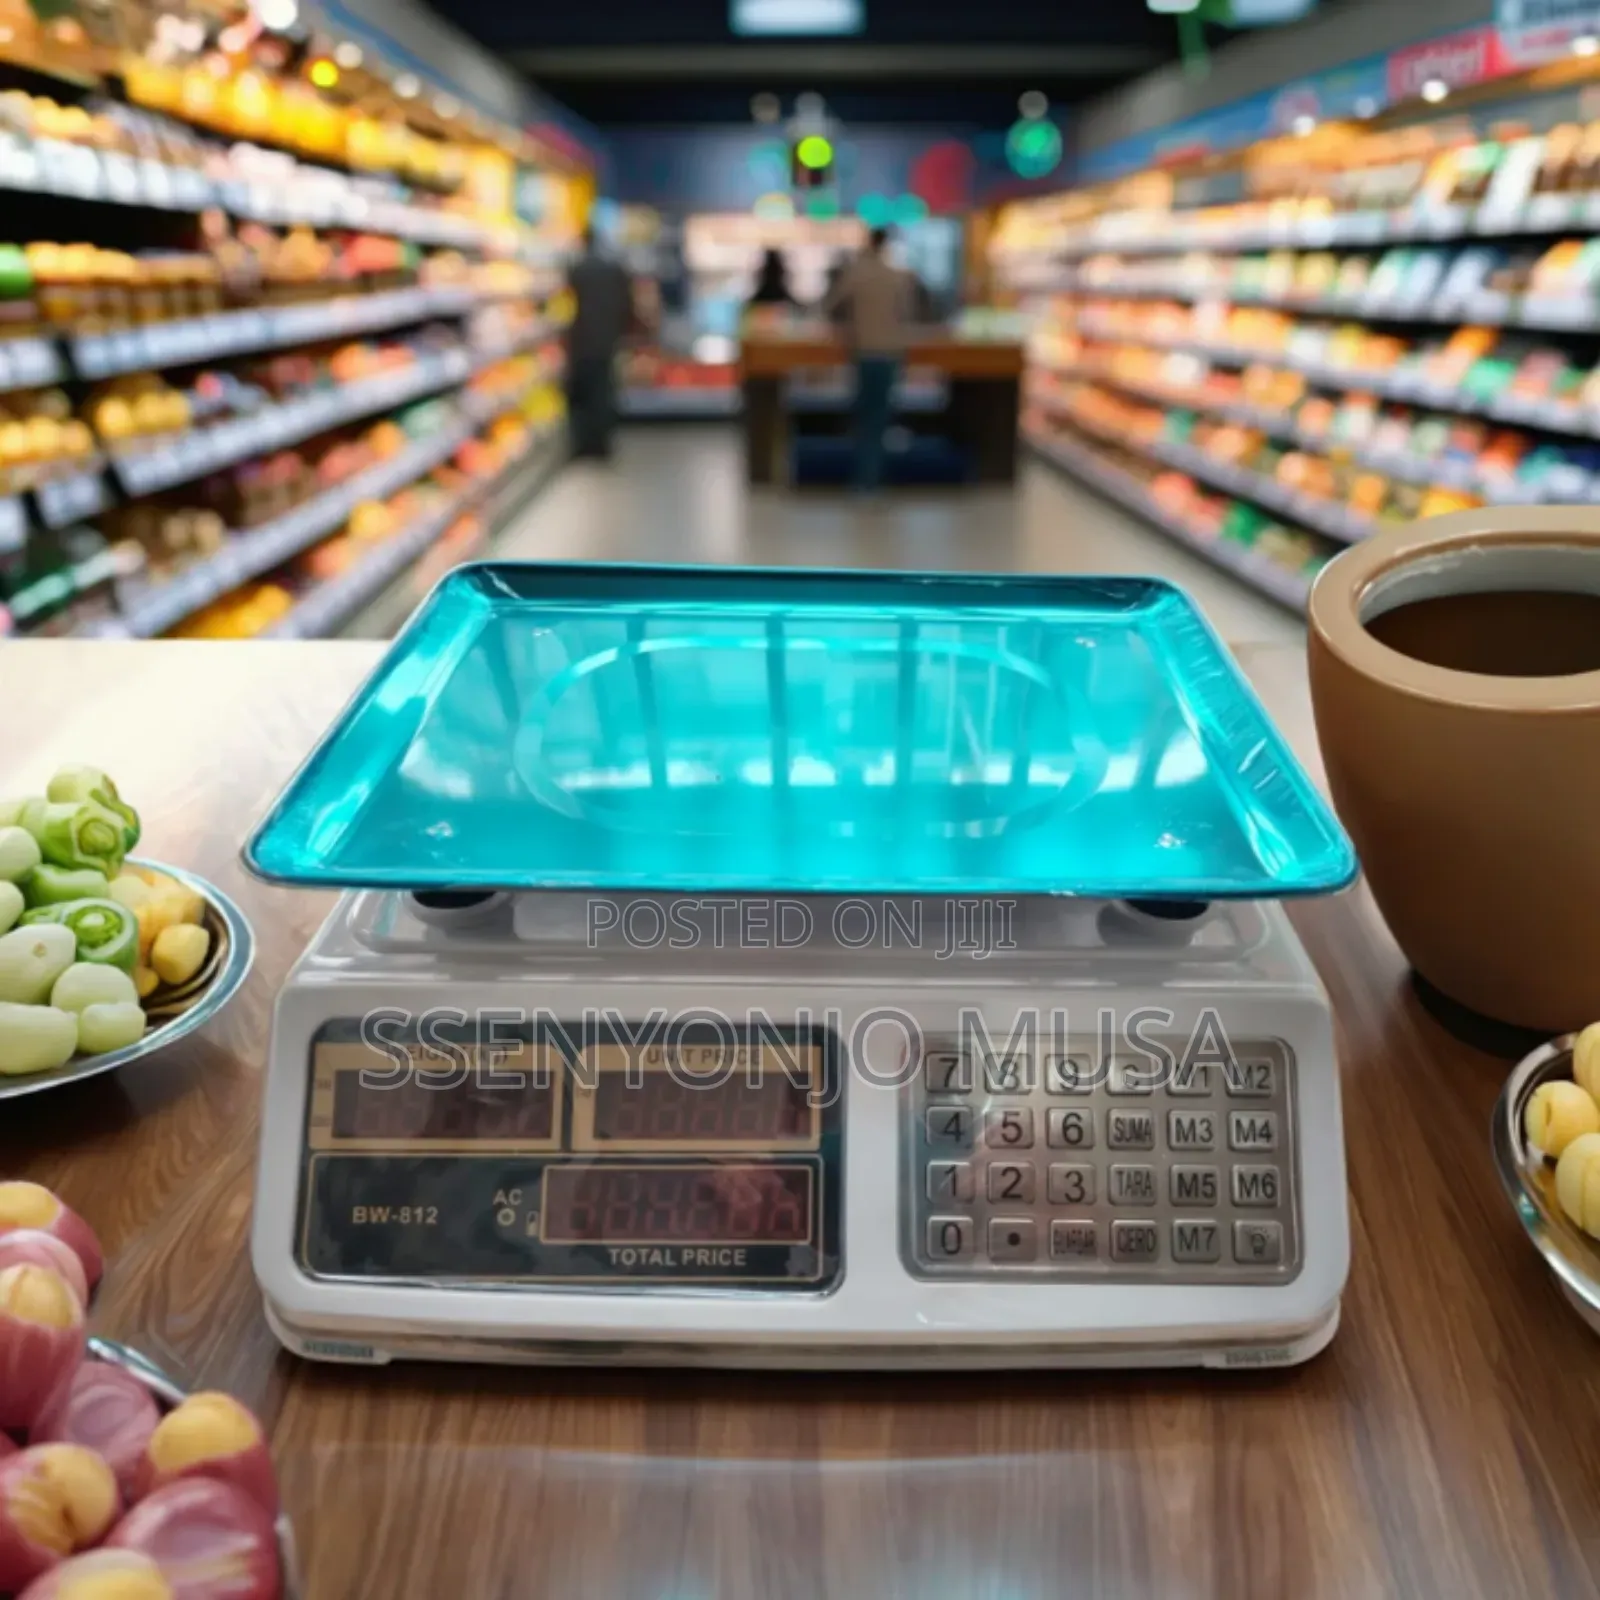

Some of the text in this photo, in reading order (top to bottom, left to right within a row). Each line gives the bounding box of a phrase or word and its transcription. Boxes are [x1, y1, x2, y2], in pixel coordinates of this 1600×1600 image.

[646, 1048, 693, 1064] UNIT
[938, 1057, 959, 1088] 7
[999, 1059, 1019, 1090] 8
[1058, 1058, 1079, 1090] 9
[1230, 1065, 1270, 1090] M2
[943, 1112, 963, 1142] 4
[1001, 1111, 1023, 1143] 5
[1062, 1112, 1083, 1145] 6
[1175, 1118, 1214, 1143] M3
[1234, 1119, 1273, 1143] M4
[944, 1164, 957, 1197] 1
[1001, 1166, 1023, 1199] 2
[1064, 1170, 1085, 1203] 3
[1116, 1170, 1154, 1197] TARA
[1177, 1172, 1216, 1199] M5
[1238, 1172, 1277, 1199] M6
[492, 1188, 523, 1206] AC
[352, 1206, 438, 1224] BW-812
[941, 1222, 962, 1255] 0
[1178, 1226, 1217, 1251] M7
[608, 1248, 747, 1266] TOTAL PRICE
